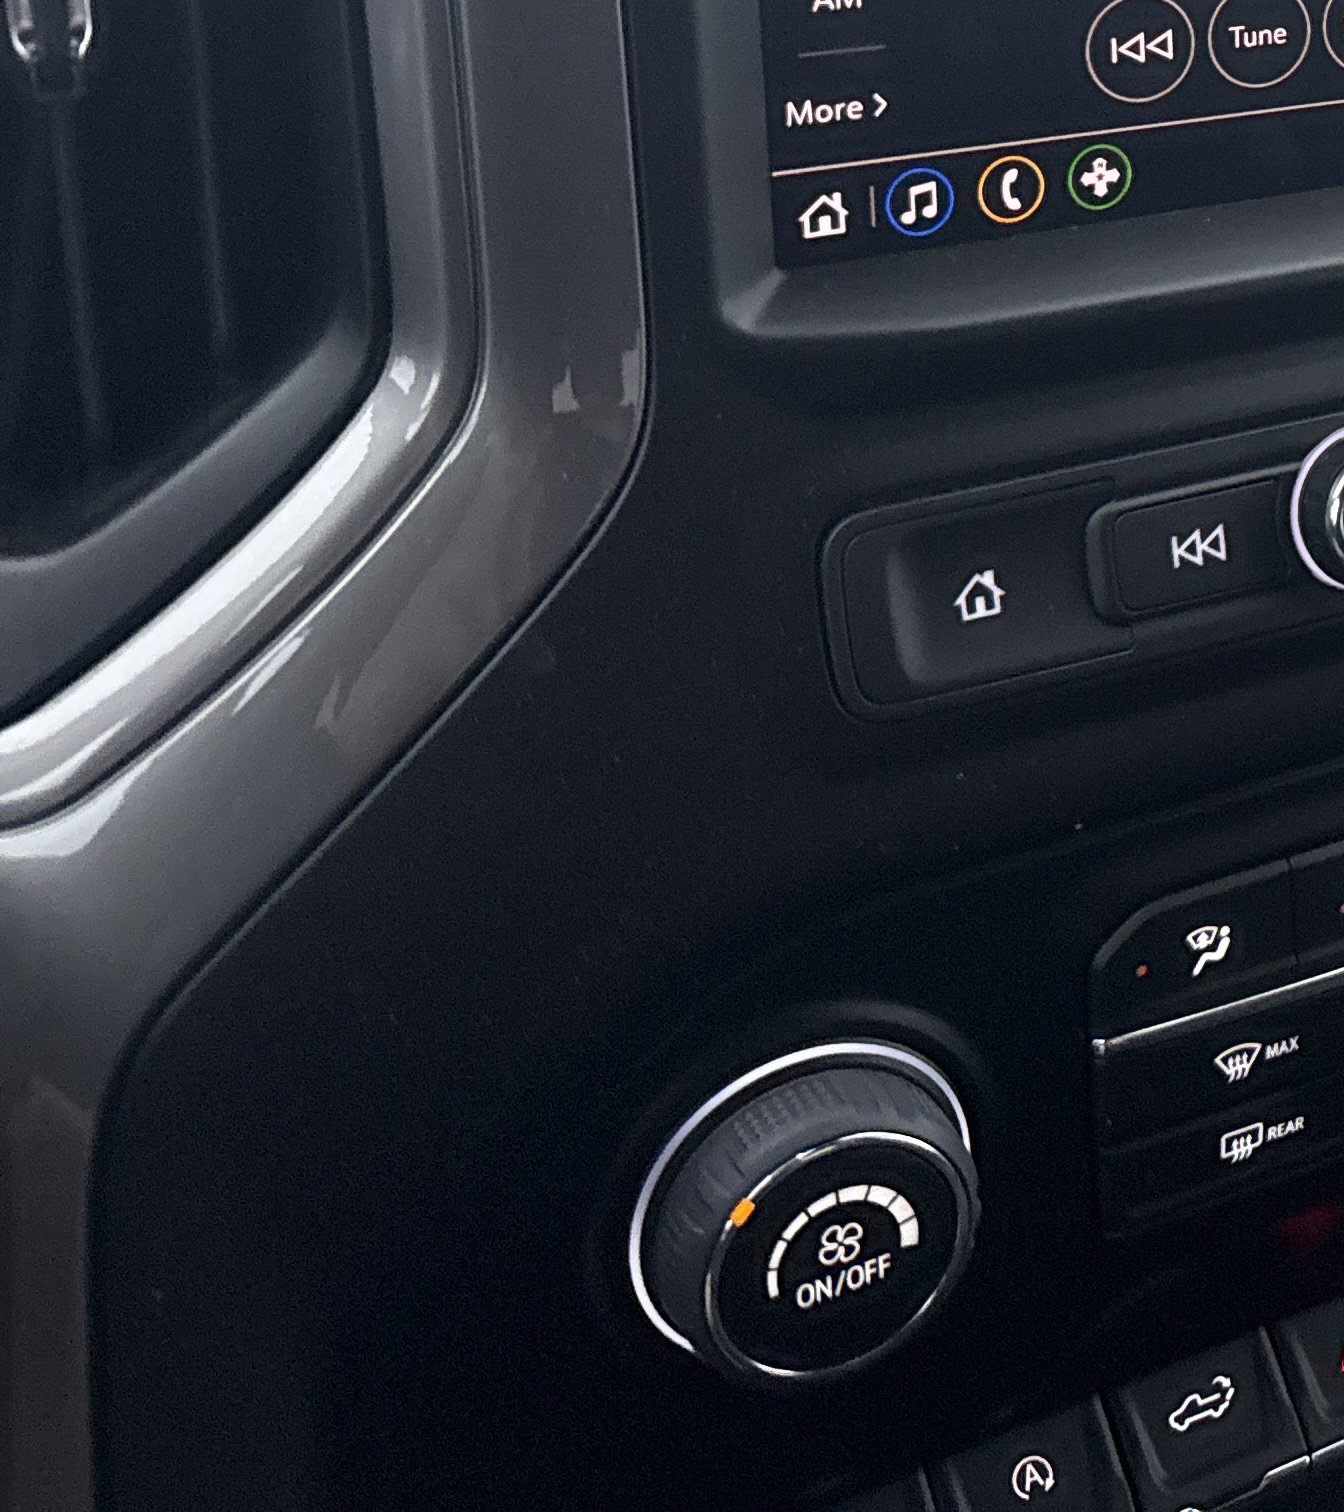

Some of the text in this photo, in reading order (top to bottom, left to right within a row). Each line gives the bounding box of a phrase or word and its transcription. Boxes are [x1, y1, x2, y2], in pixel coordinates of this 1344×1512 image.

[1227, 23, 1288, 50] Tune
[784, 98, 864, 129] More
[1264, 1033, 1301, 1061] MAX
[1266, 1114, 1305, 1142] REAR
[796, 1253, 893, 1310] ON/OFF
[1025, 1462, 1045, 1492] A
